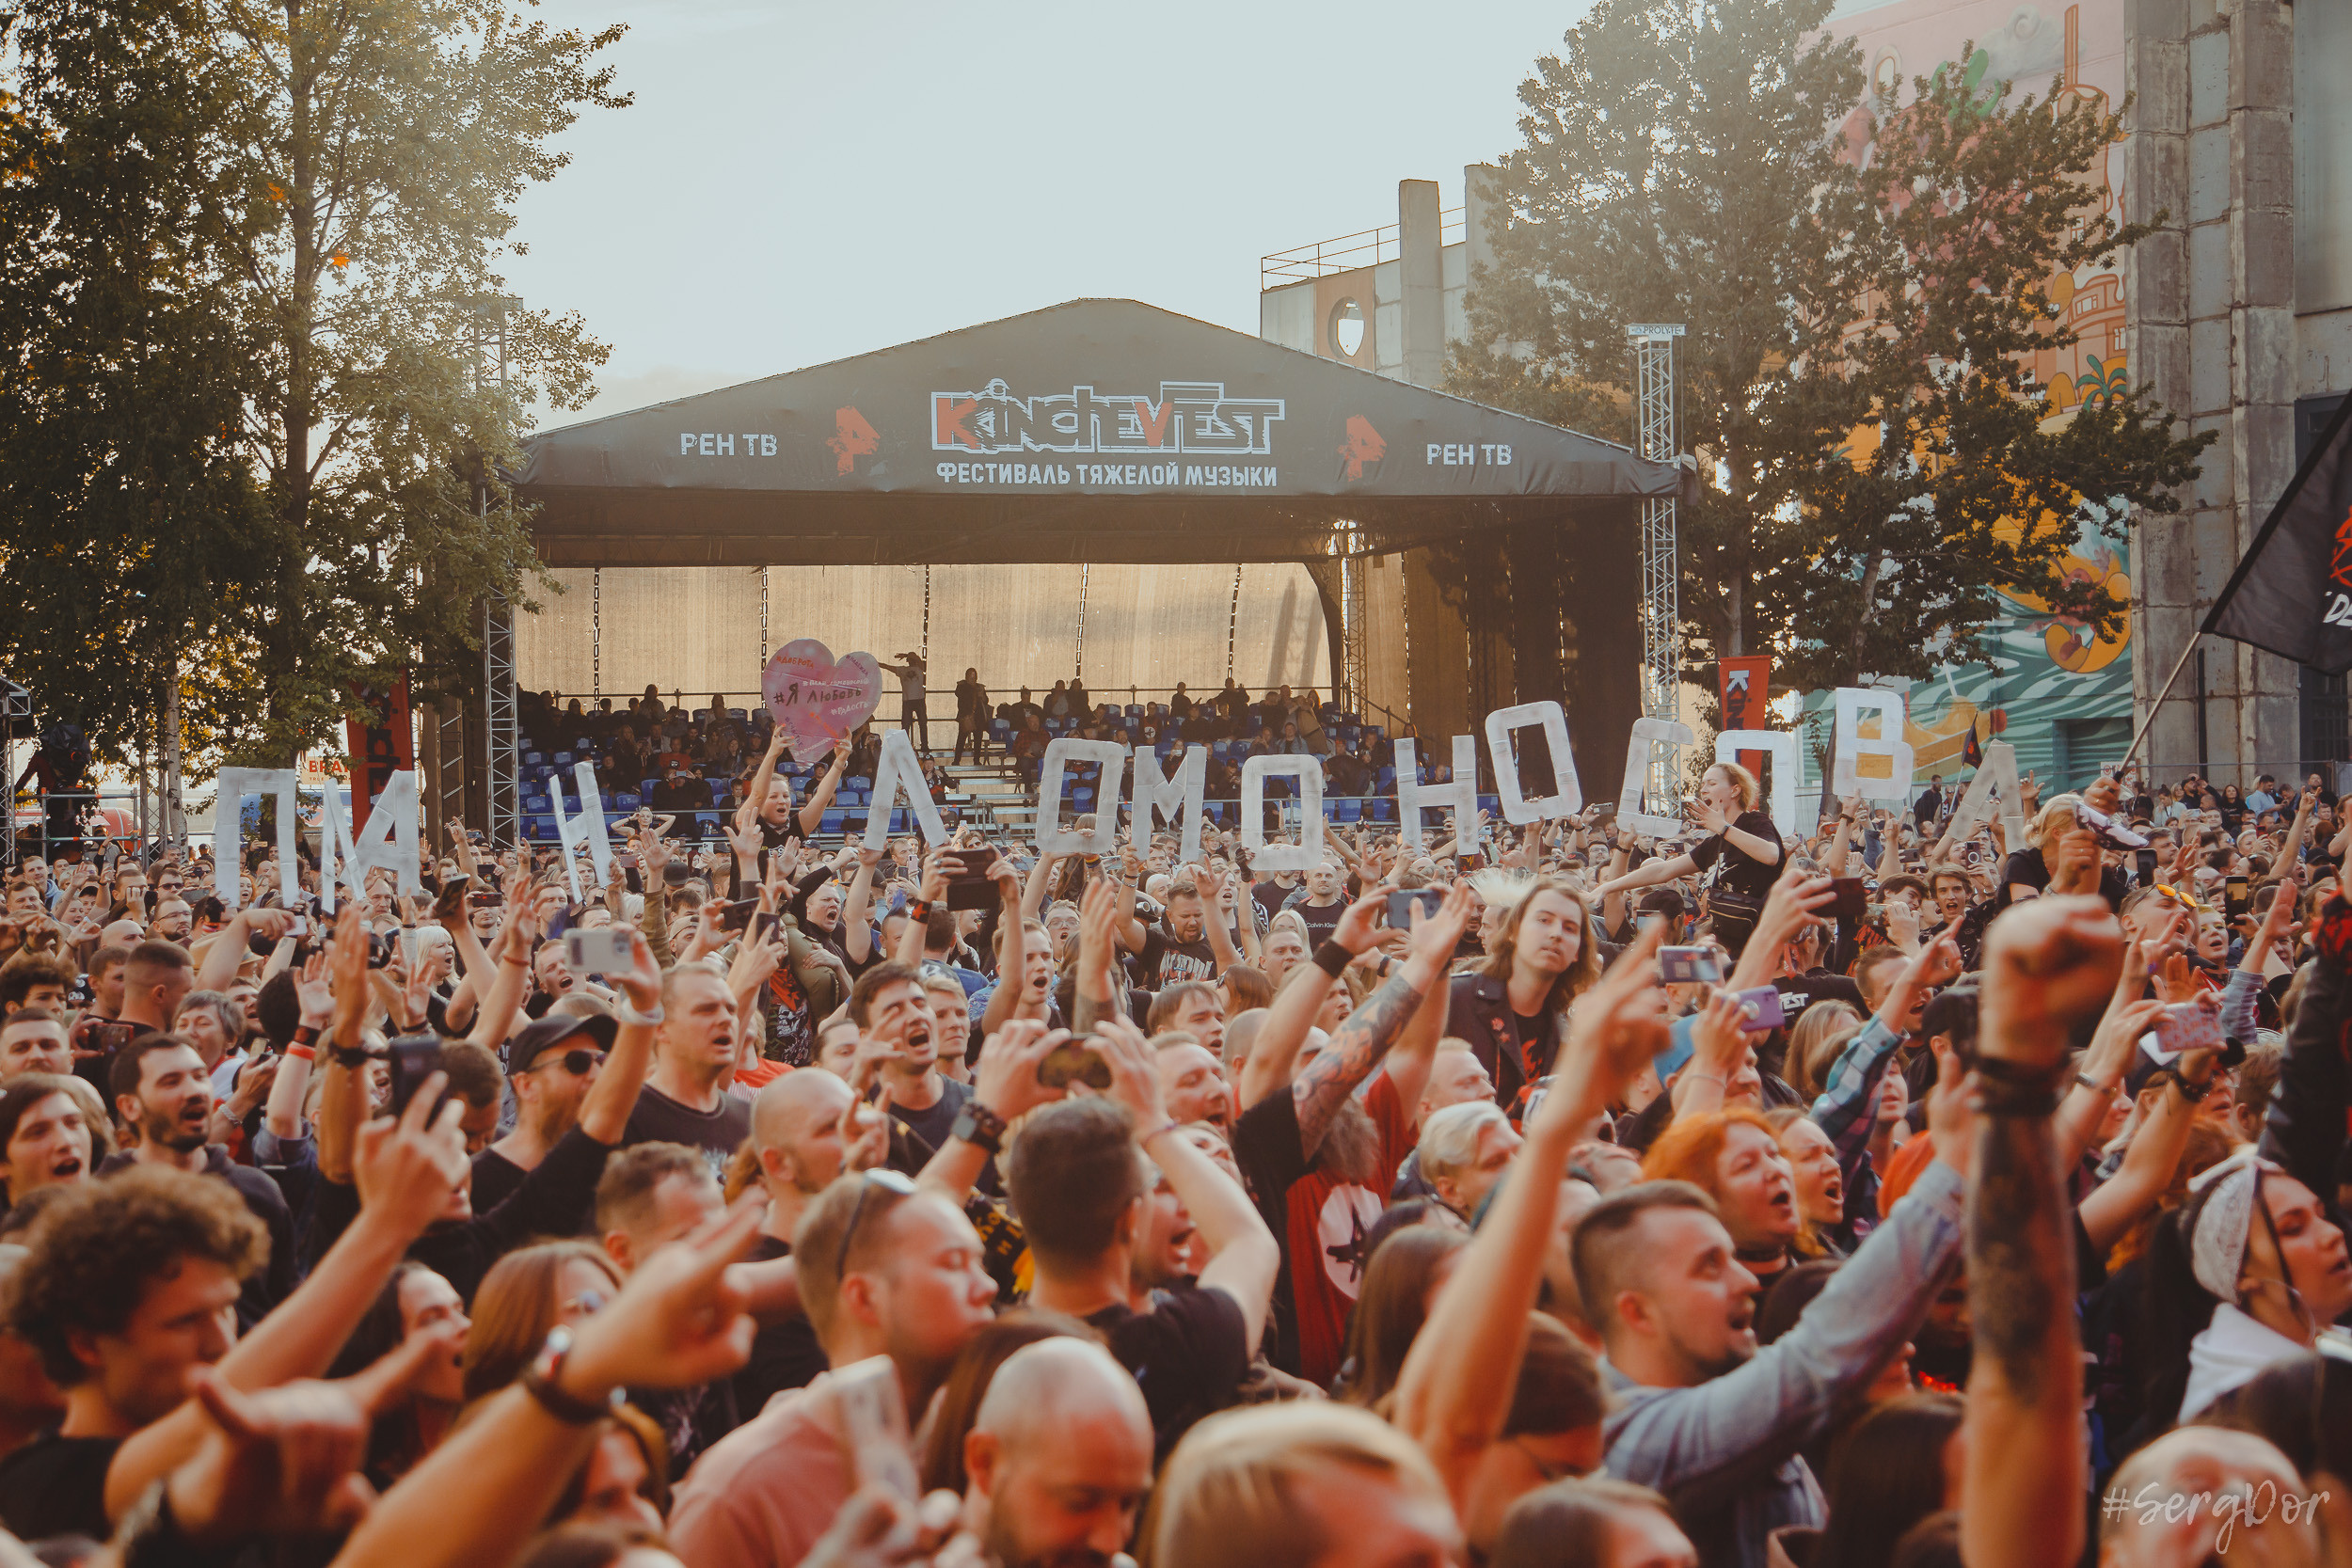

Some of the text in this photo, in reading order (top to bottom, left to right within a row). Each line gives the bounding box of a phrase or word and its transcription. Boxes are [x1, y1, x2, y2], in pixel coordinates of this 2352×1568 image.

[680, 433, 778, 456] РЕН ТВ
[1426, 443, 1512, 466] РЕН ТВ
[936, 461, 1278, 487] ФЕСТИВАЛЬ ТЯЖЕЛОЙ МУЗЫКИ
[806, 689, 862, 704] ЛЮБОВЬ
